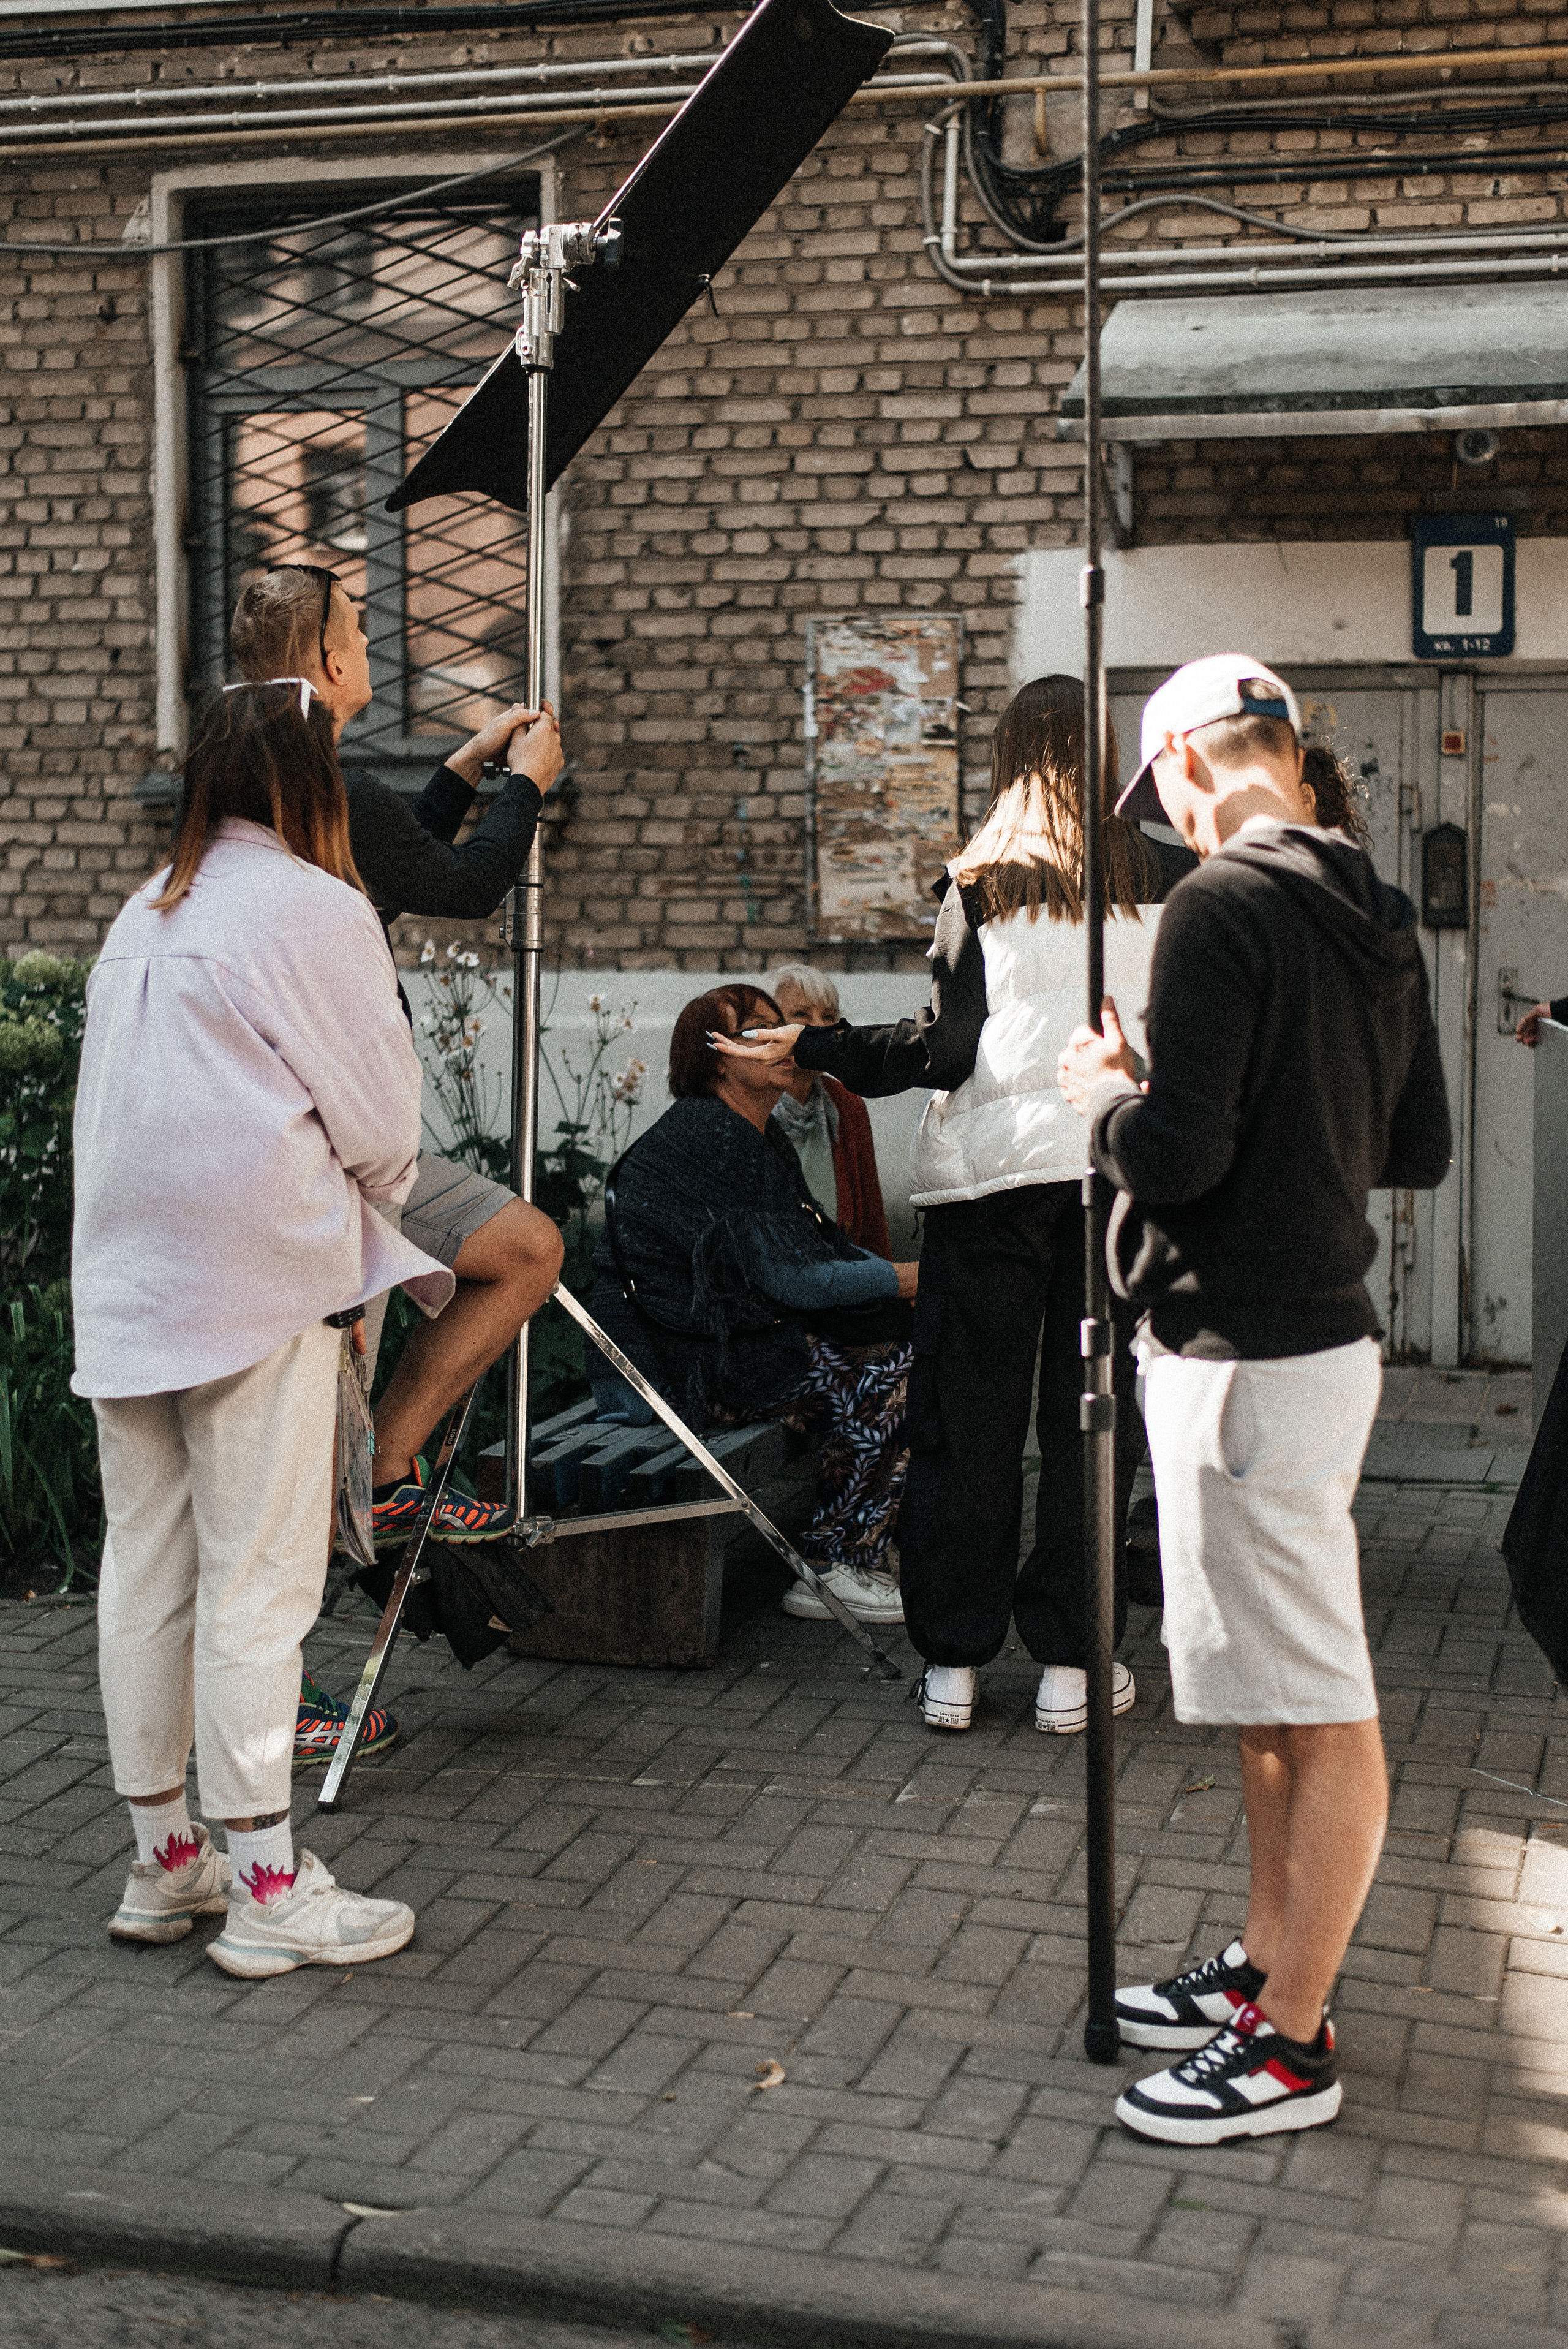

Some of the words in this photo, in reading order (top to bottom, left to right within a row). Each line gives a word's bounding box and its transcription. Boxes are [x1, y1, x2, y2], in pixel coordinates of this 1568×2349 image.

[1450, 550, 1473, 615] 1
[1461, 638, 1490, 651] 1-12
[447, 1428, 458, 1445] FIRST
